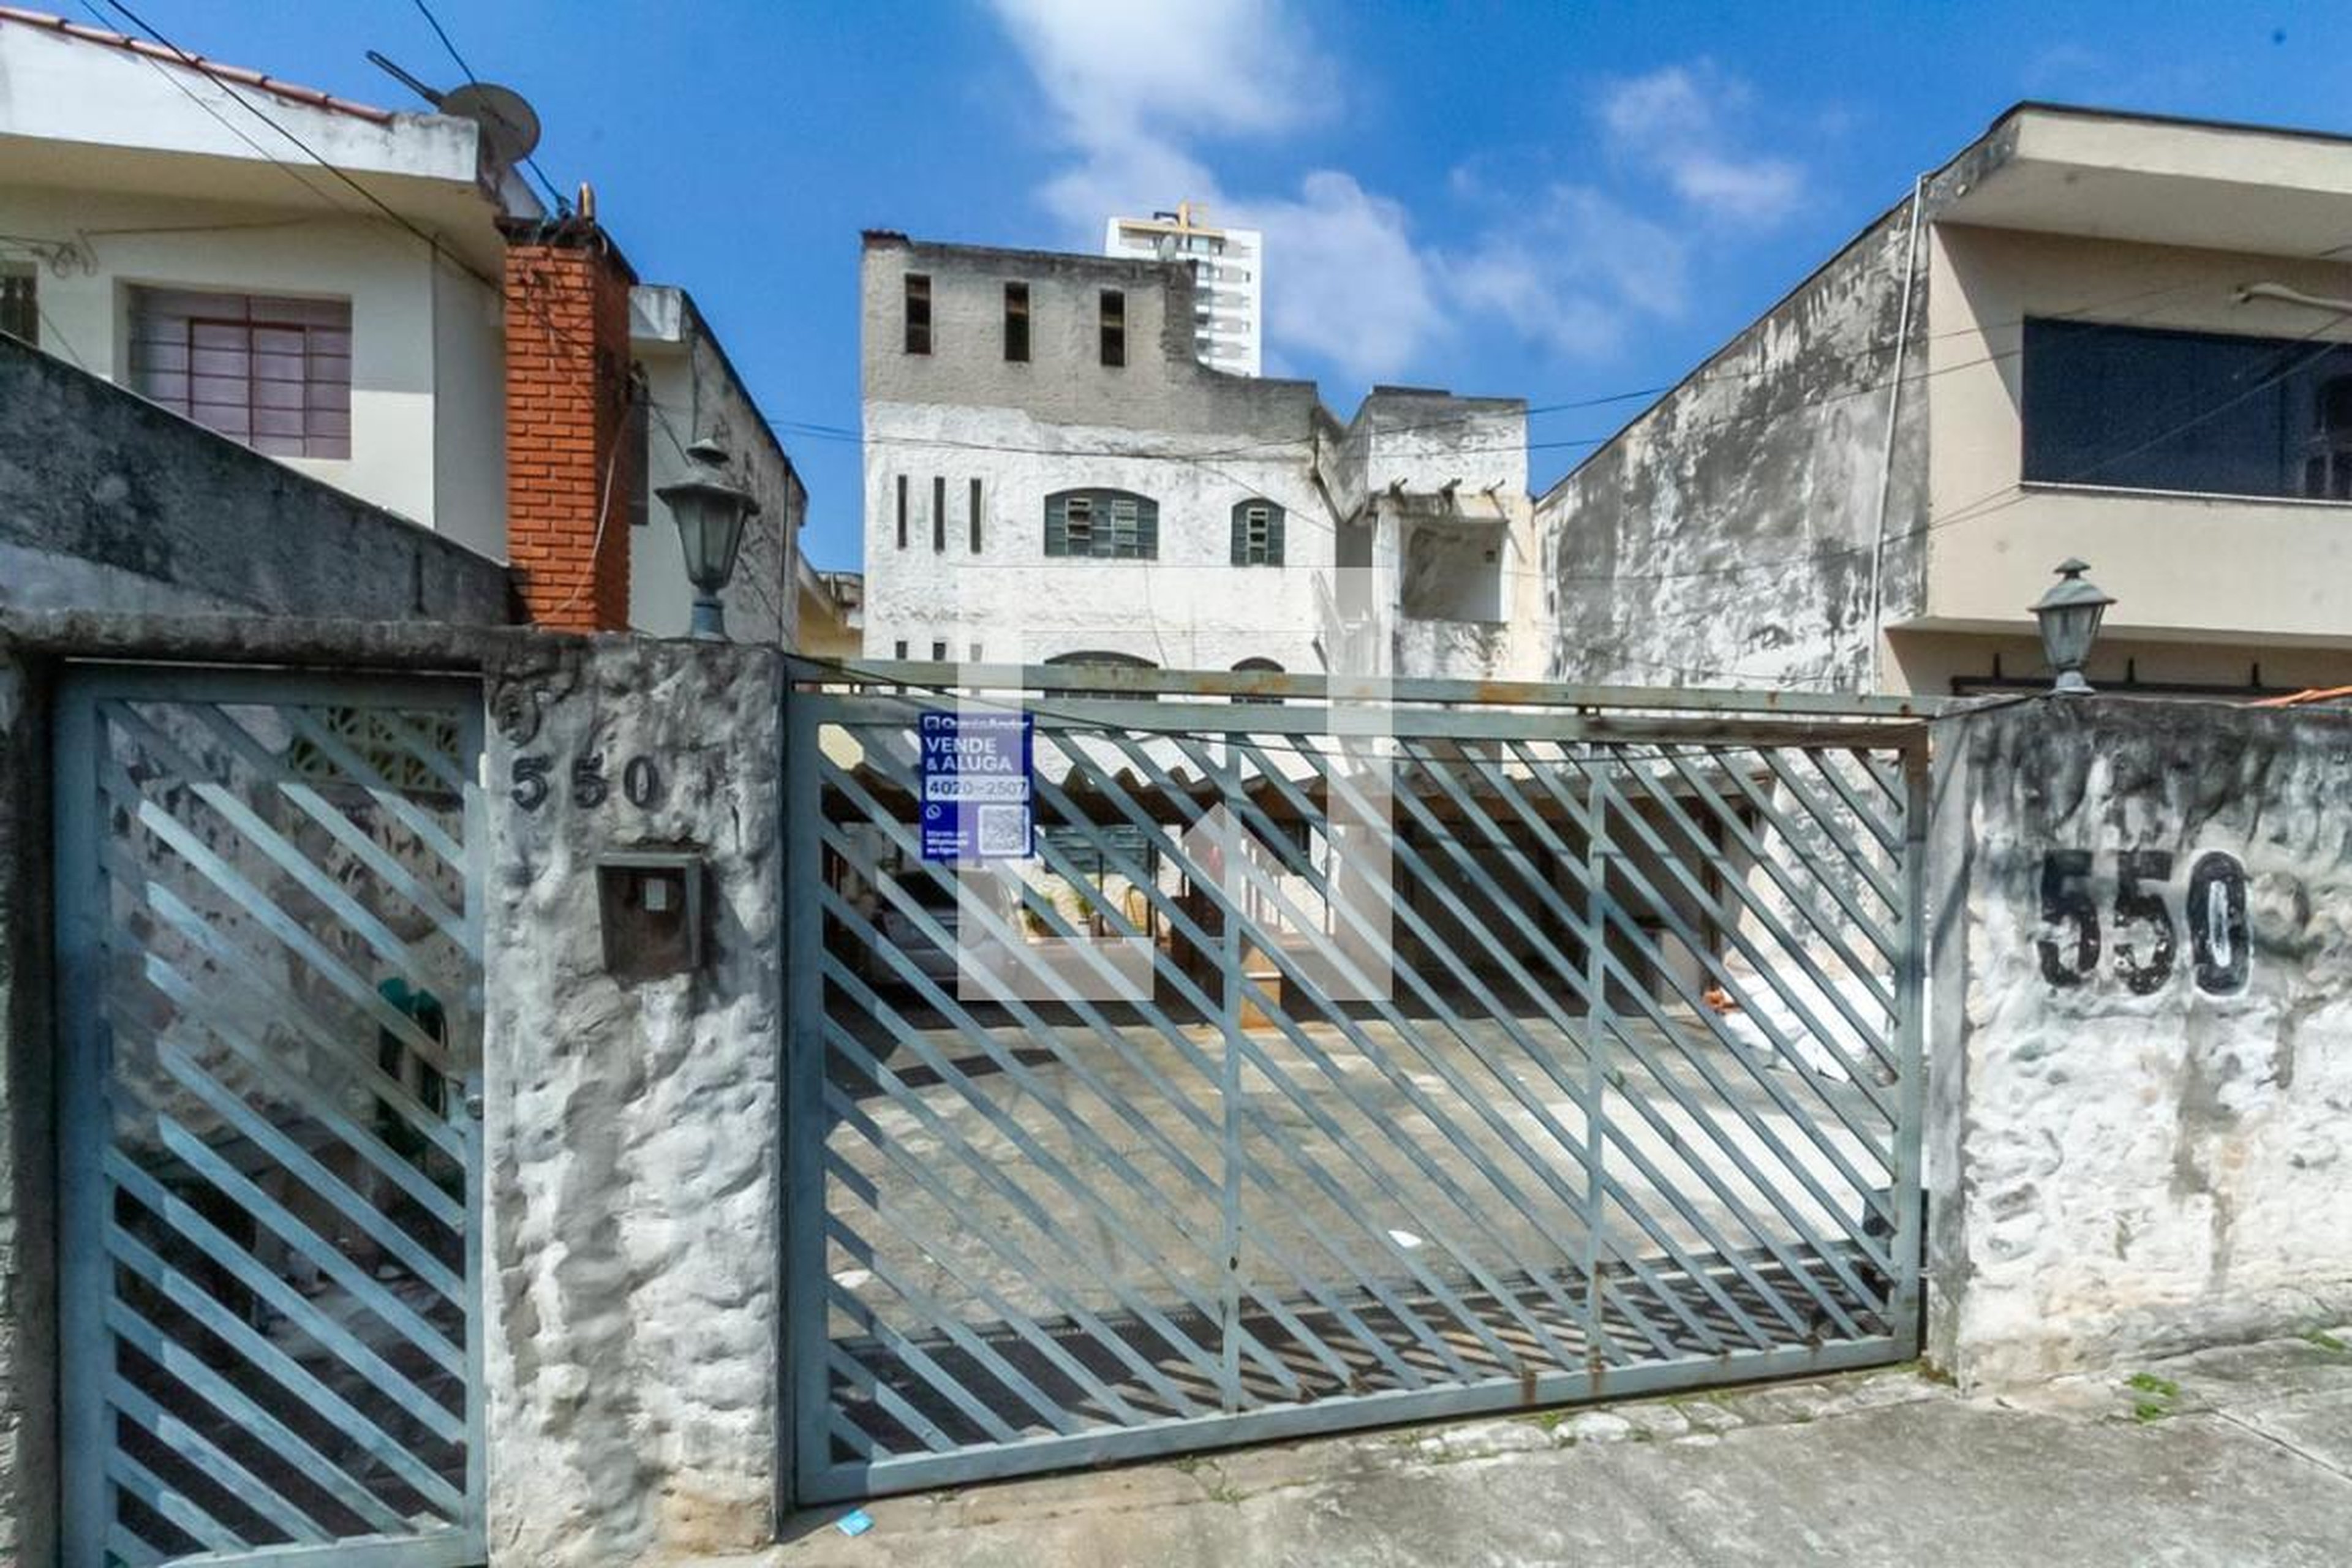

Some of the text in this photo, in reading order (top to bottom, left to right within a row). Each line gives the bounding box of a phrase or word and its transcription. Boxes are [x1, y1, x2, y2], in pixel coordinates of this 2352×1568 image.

[925, 737, 997, 754] VENDE
[941, 755, 1012, 771] ALUGA
[511, 753, 658, 812] 550
[2037, 848, 2252, 997] 550
